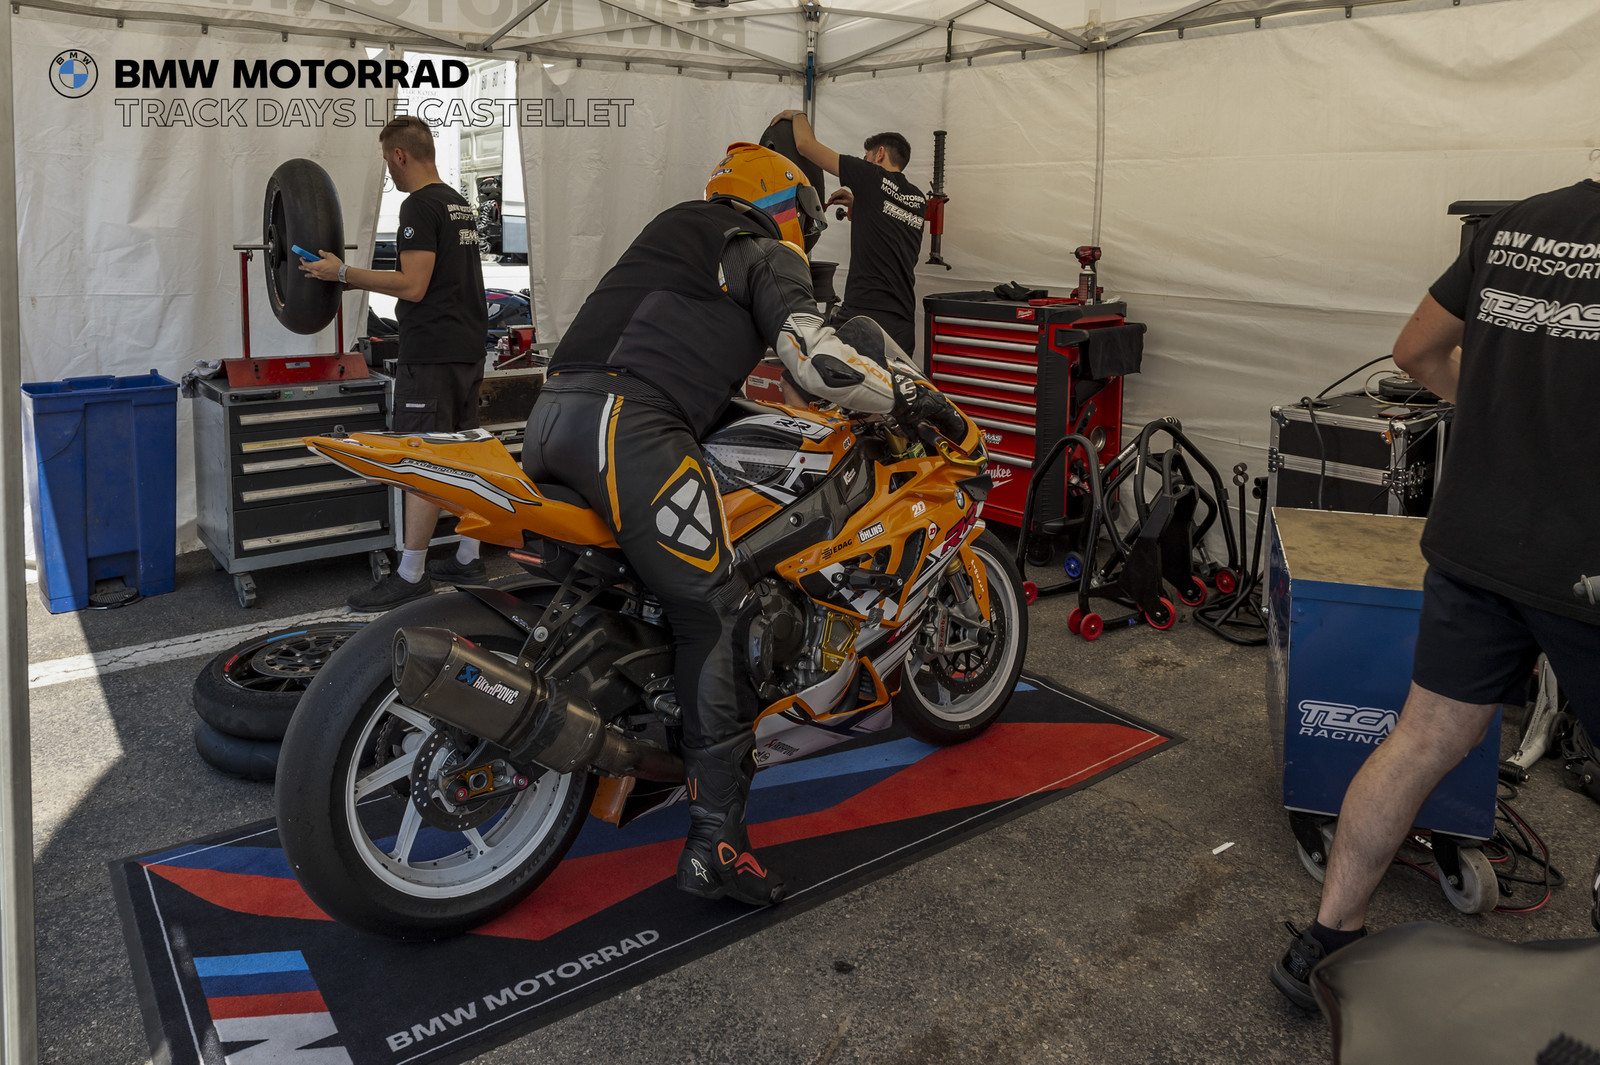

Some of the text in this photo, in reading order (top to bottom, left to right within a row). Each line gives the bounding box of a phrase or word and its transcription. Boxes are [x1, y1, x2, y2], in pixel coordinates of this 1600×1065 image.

[882, 177, 899, 192] BMW
[1477, 312, 1538, 333] RACNG
[775, 418, 811, 431] RR
[911, 502, 926, 515] 2D
[833, 538, 853, 554] EDAG
[385, 928, 661, 1053] BMW MOTORRAD
